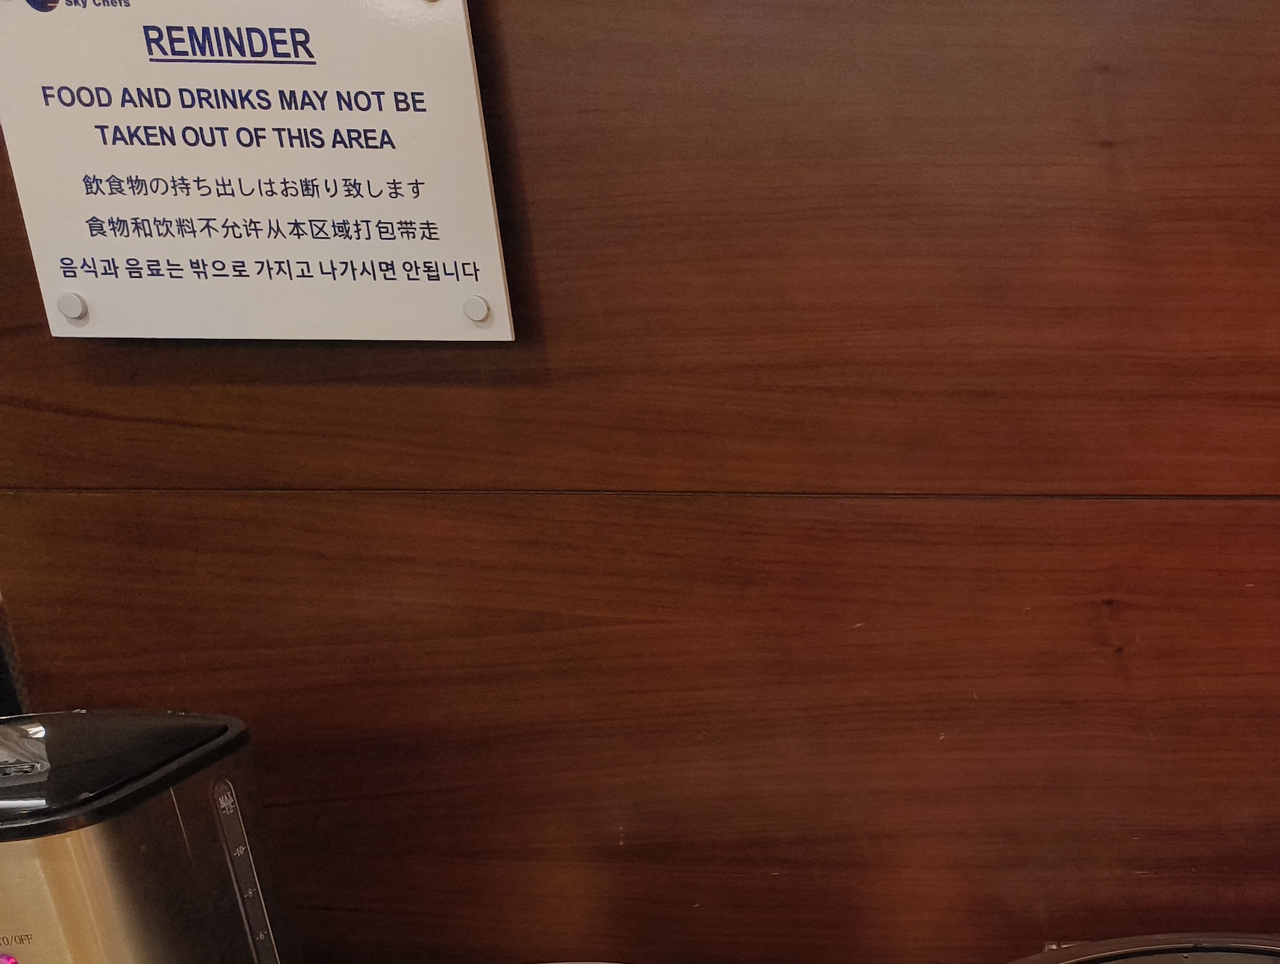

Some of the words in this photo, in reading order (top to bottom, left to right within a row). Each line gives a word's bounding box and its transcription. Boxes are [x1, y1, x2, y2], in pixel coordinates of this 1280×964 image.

[142, 25, 315, 60] REMINDER
[41, 85, 113, 108] FOOD
[120, 87, 172, 109] AND
[178, 88, 272, 110] DRINKS
[278, 89, 328, 111] MAY
[335, 90, 386, 112] NOT
[393, 91, 427, 113] BE
[94, 125, 177, 147] TAKEN
[181, 126, 229, 147] OUT
[235, 126, 267, 148] OF
[271, 127, 326, 149] THIS
[331, 128, 397, 150] AREA
[82, 174, 426, 199] 飲食物の持ち出しはお断り致します
[85, 215, 441, 241] 食物和饮料不允许从本区域打包带走
[59, 256, 120, 279] 음식과
[124, 257, 185, 280] 음료는
[189, 258, 250, 280] 밖으로
[254, 259, 314, 281] 가지고
[318, 259, 398, 282] 나가시면
[402, 260, 480, 282] 안됩니다
